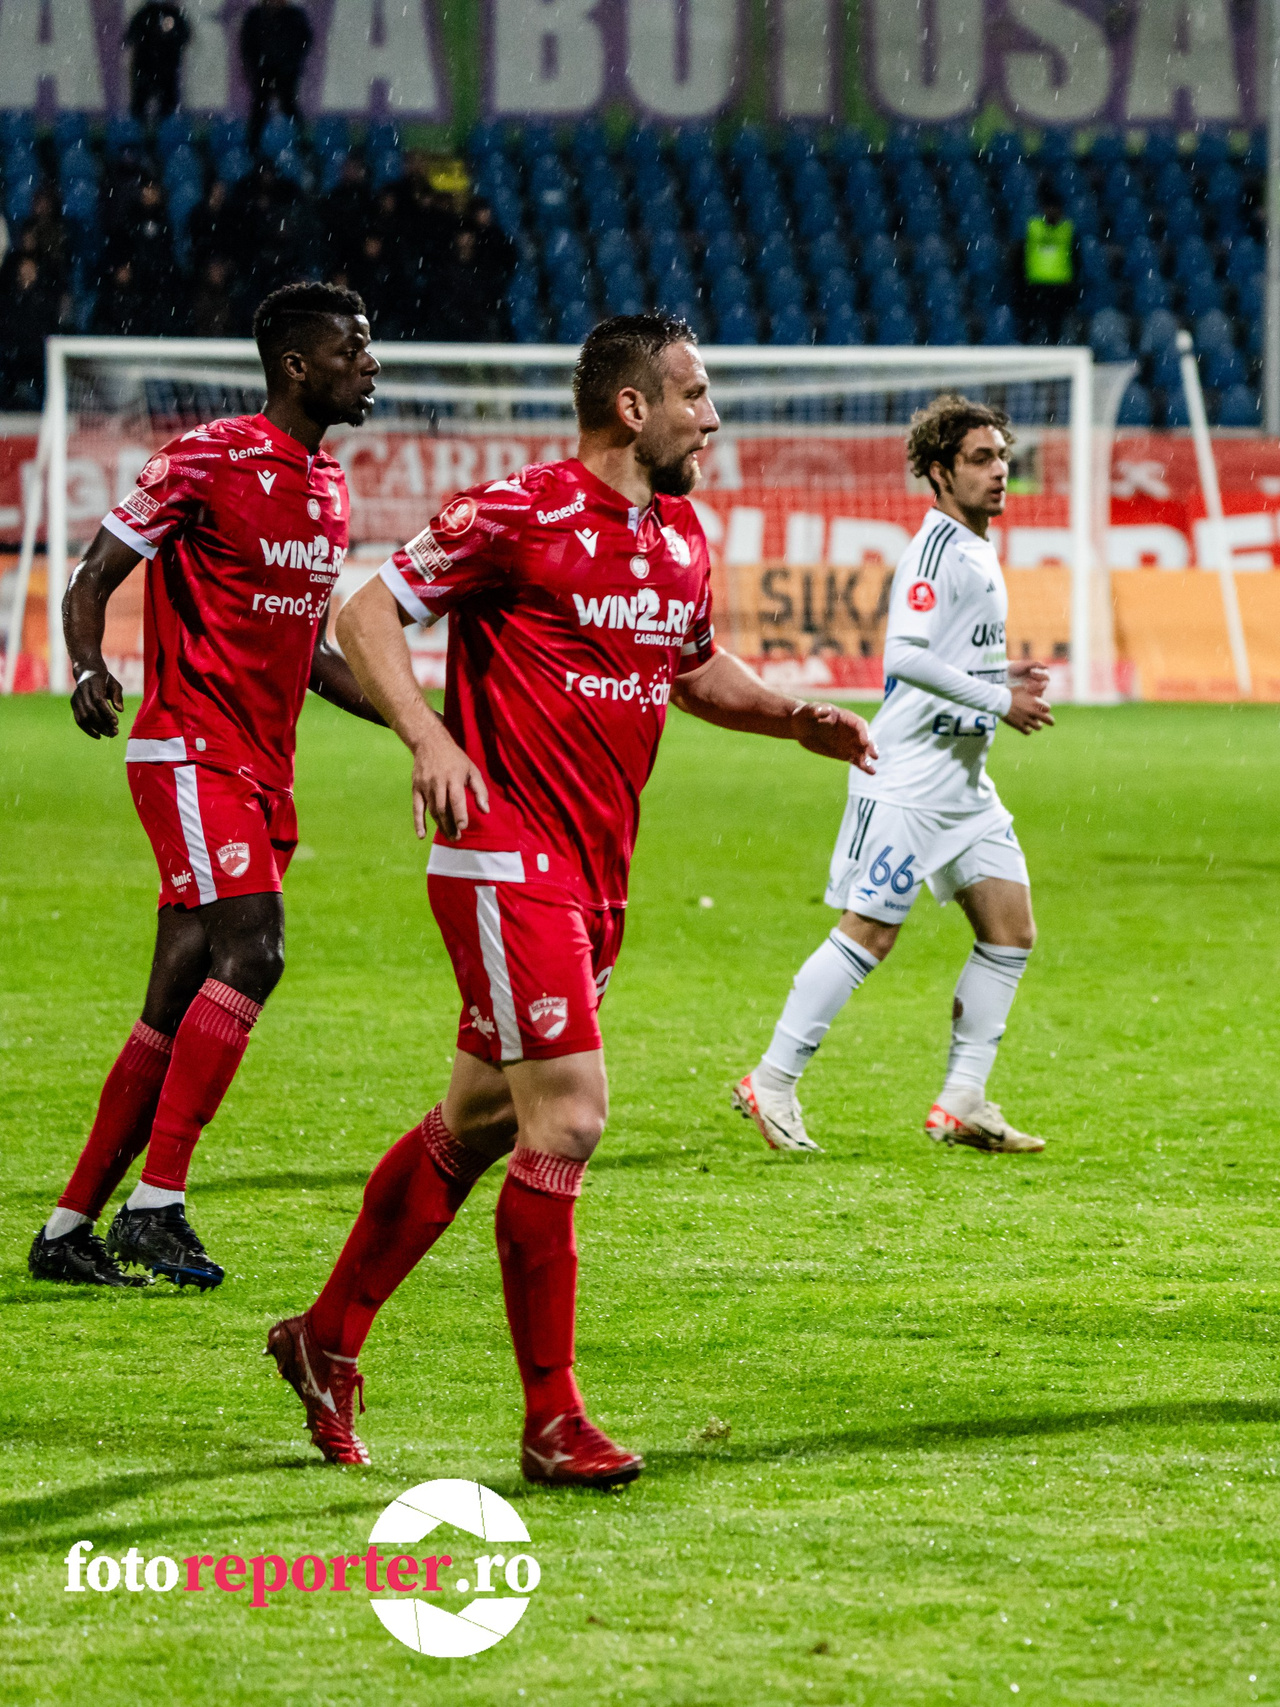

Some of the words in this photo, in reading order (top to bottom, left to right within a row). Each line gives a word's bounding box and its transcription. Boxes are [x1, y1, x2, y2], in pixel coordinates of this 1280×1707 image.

[536, 500, 586, 525] Beneva
[634, 632, 664, 646] CASINO
[869, 845, 916, 895] 66
